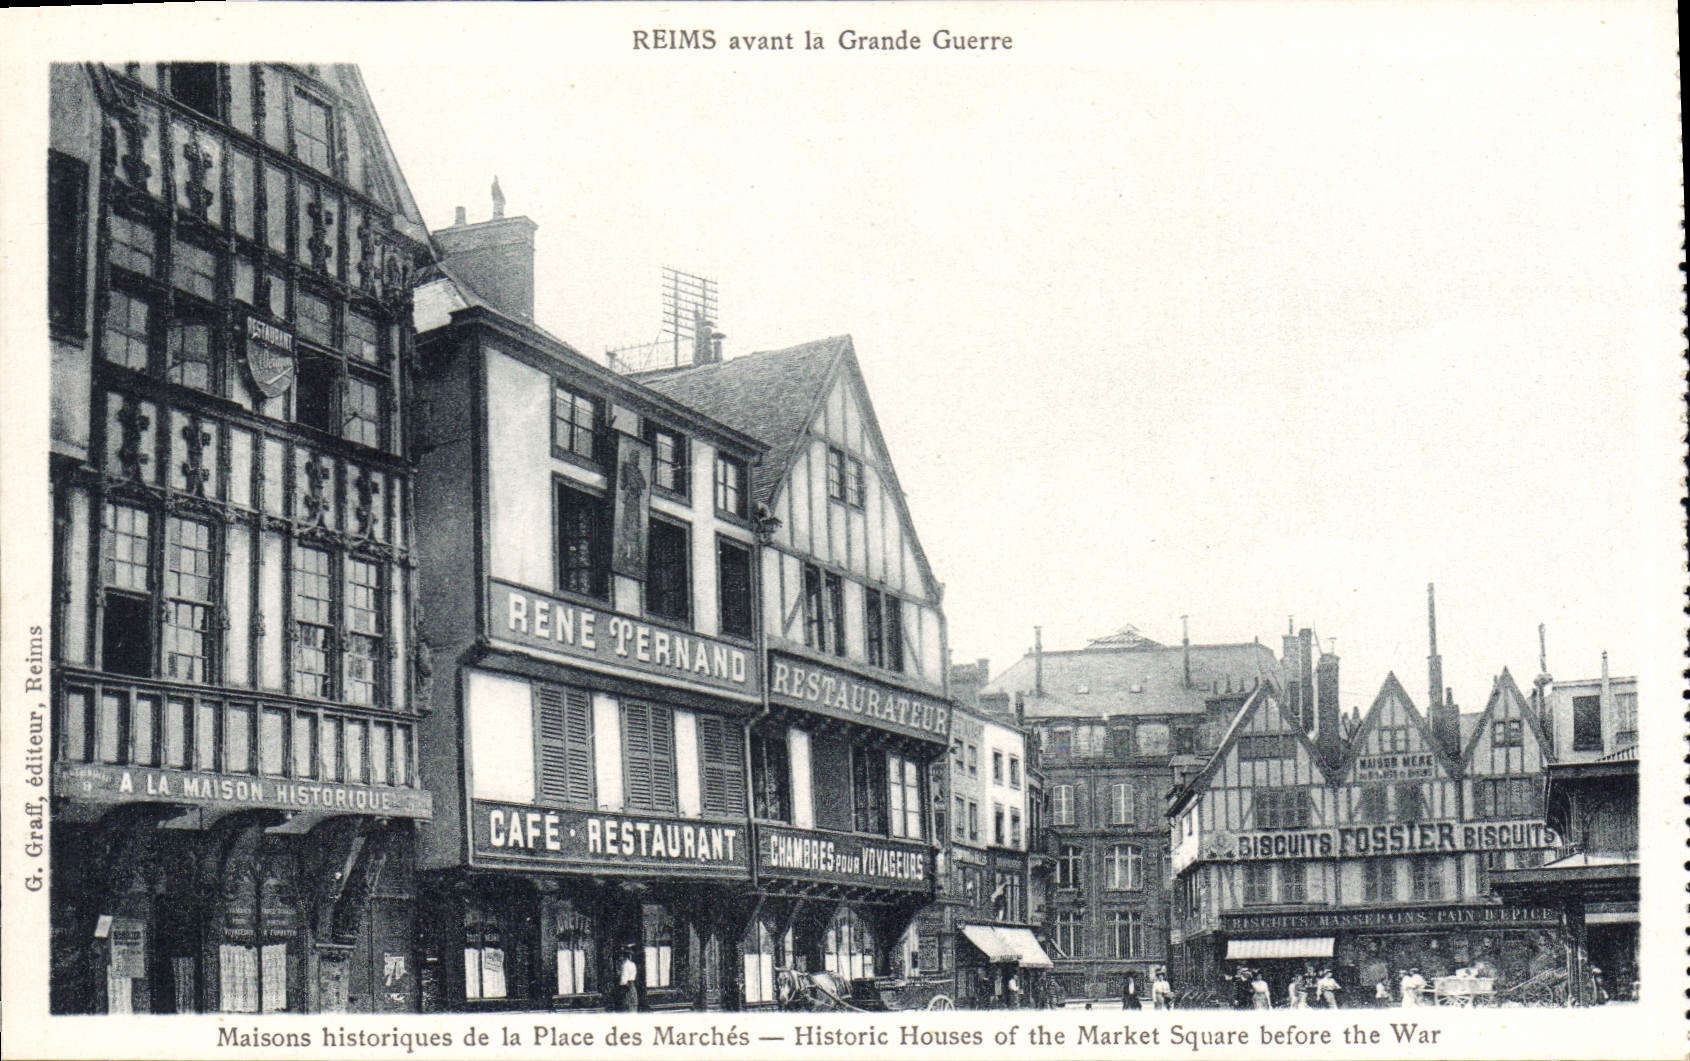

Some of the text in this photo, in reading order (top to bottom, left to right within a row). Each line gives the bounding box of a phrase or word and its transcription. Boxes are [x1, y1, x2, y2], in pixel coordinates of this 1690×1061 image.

[508, 592, 597, 651] RENÉ
[771, 662, 949, 736] RESTAURATEUR
[119, 771, 133, 793] A
[147, 774, 170, 796] LA
[183, 777, 263, 801] MAISON
[276, 784, 390, 810] HISTORIQUE
[489, 809, 736, 861] CAFÉ RESTAURANT
[1238, 832, 1333, 857] BISCUITS
[1338, 821, 1456, 854] FOSSIER
[1464, 822, 1556, 848] BISCUITS
[770, 835, 834, 872] CHAMBRES
[835, 854, 860, 874] POUR
[862, 846, 924, 881] VOYAGEURS
